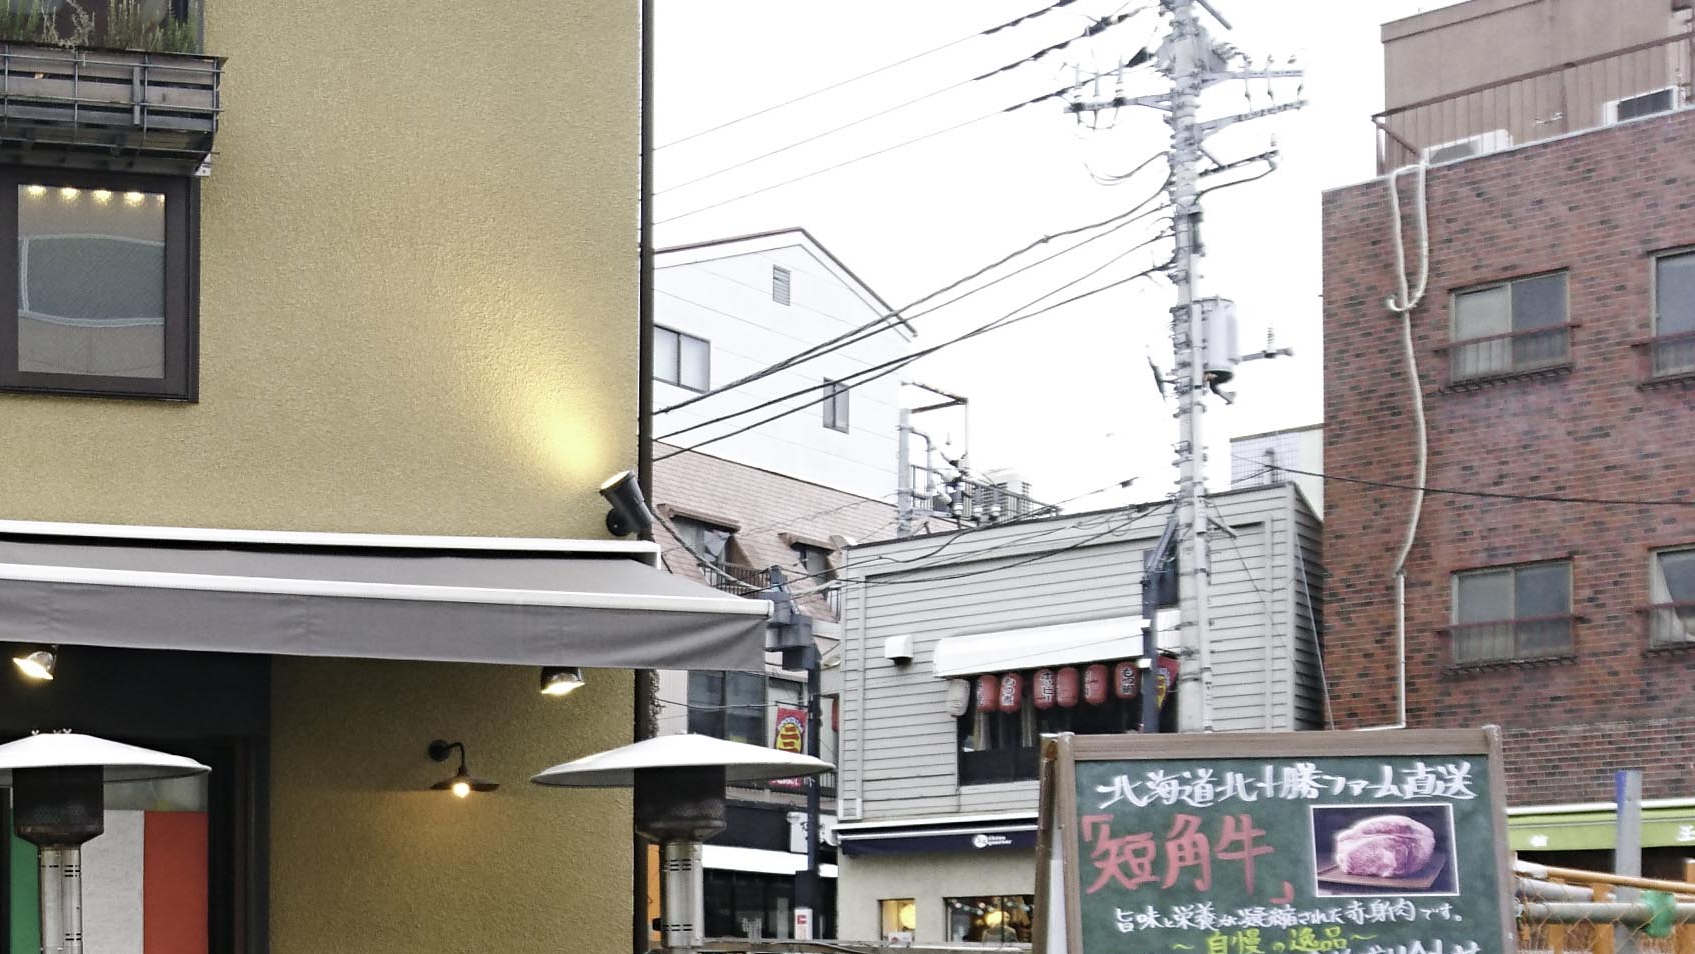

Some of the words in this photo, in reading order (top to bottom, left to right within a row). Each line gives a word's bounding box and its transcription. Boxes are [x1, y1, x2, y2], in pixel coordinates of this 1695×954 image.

[1096, 762, 1478, 809] 北海道北十勝ファーム直送
